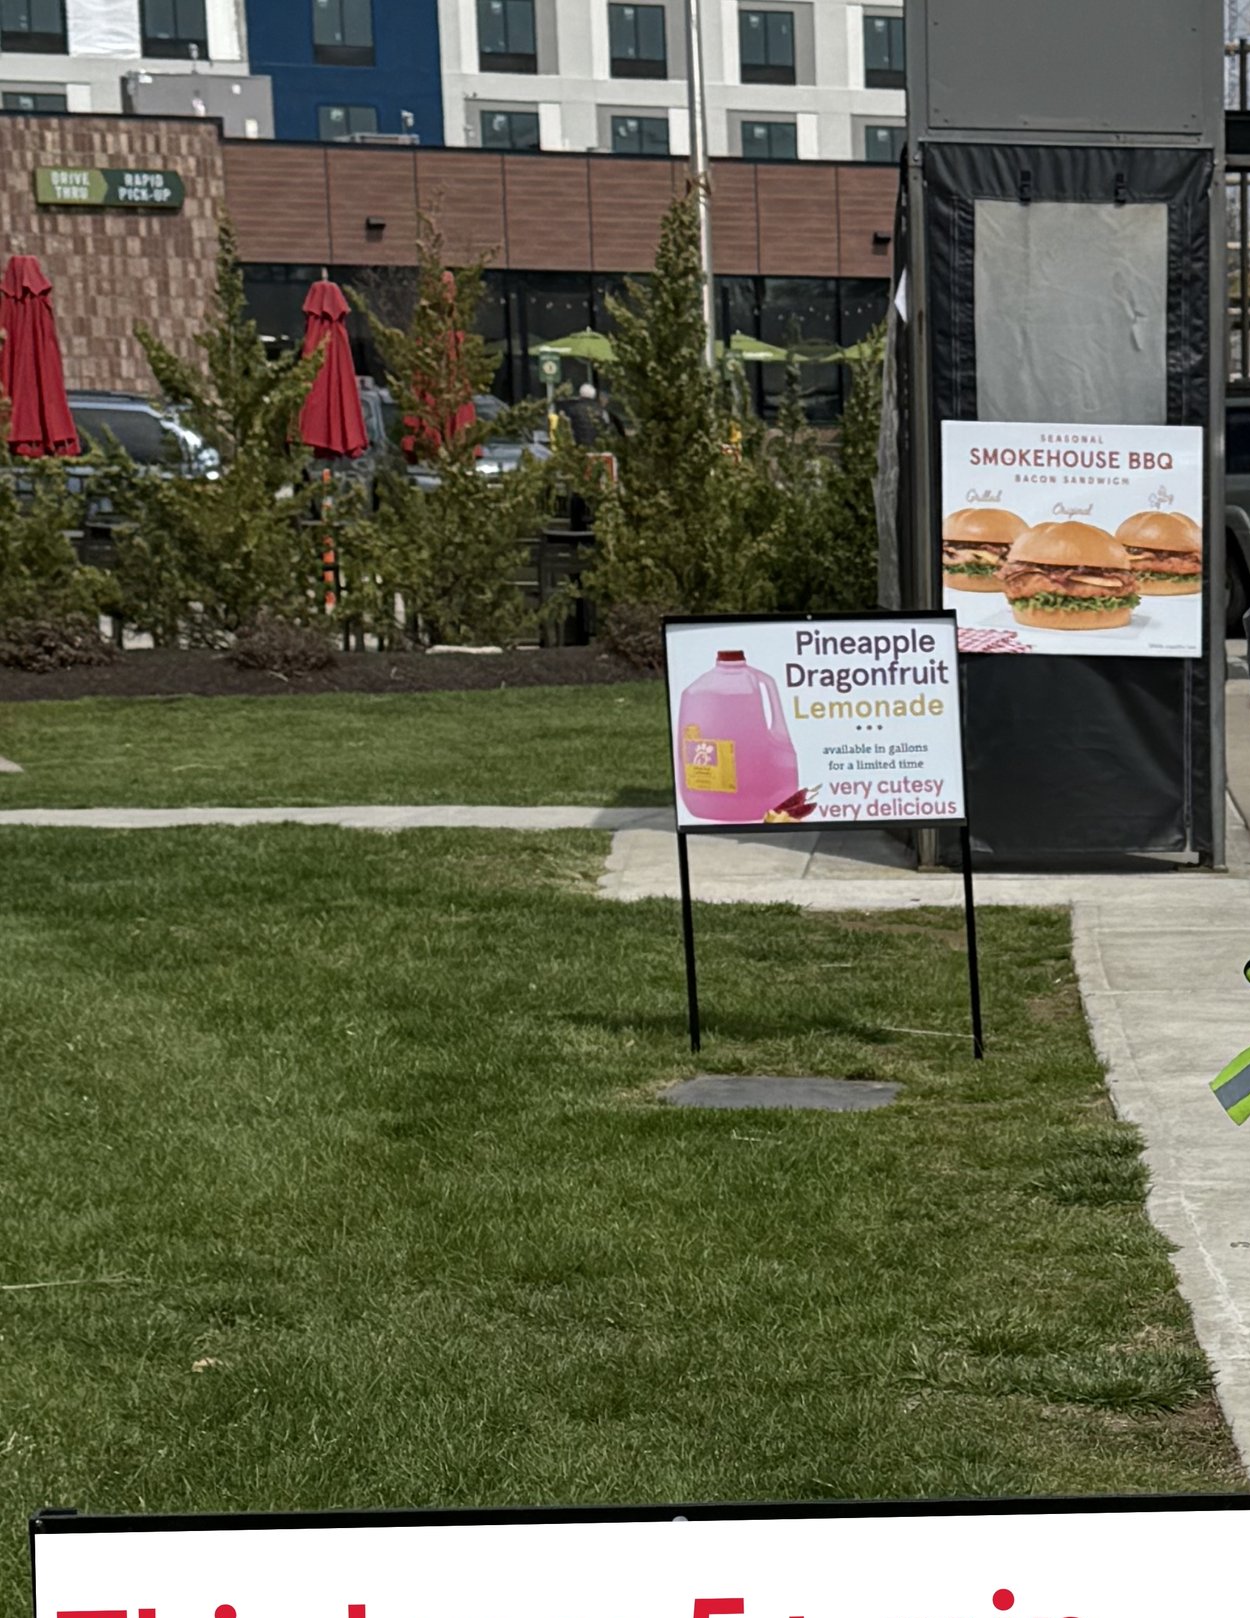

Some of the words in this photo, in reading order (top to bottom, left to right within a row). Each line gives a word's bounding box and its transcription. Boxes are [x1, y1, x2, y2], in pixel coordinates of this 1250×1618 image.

[51, 171, 90, 185] DRIVE
[124, 173, 163, 187] RAPID
[54, 186, 88, 199] THRU
[118, 187, 171, 201] PICK-UP
[1040, 434, 1104, 444] SEASONAL
[969, 448, 1120, 468] SMOKEHOUSE
[1129, 452, 1173, 470] BBQ
[1015, 474, 1056, 484] BACON
[1063, 475, 1130, 485] SANDWICH
[796, 628, 935, 661] Pineapple
[786, 659, 949, 693] Dragonfruit
[794, 693, 944, 719] Lemonade
[823, 744, 871, 755] available
[875, 744, 886, 754] in
[889, 743, 928, 756] gallons
[828, 761, 844, 771] for
[856, 760, 896, 770] limited
[899, 760, 924, 770] time
[829, 781, 872, 798] very
[877, 776, 943, 797] cutesy
[819, 803, 861, 820] very
[866, 798, 957, 816] delicious
